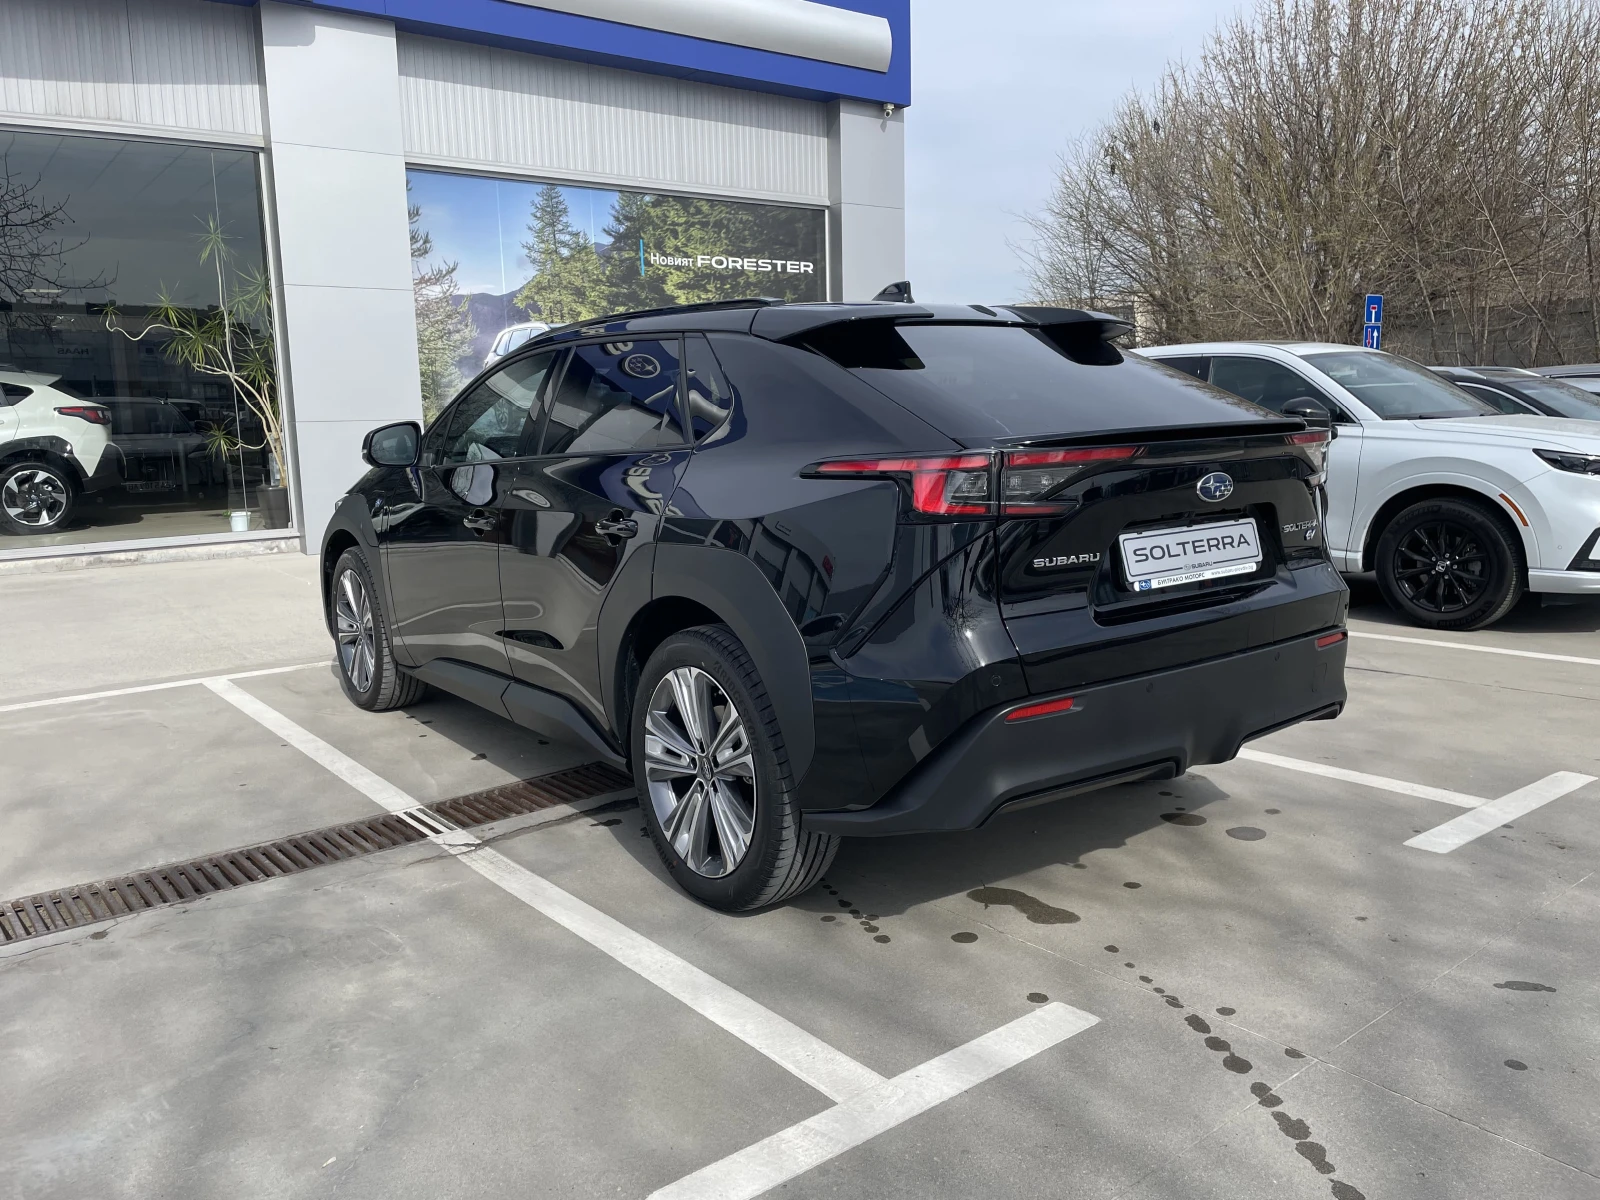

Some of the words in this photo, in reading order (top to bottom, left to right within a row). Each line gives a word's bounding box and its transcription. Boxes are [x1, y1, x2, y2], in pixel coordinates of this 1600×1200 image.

[650, 252, 693, 267] Новият
[697, 255, 814, 274] FORESTER
[1282, 519, 1319, 533] SOLTERRA
[1133, 533, 1251, 563] SOLTERRA
[1033, 552, 1100, 568] SUBARU
[1191, 561, 1213, 569] SUBARU
